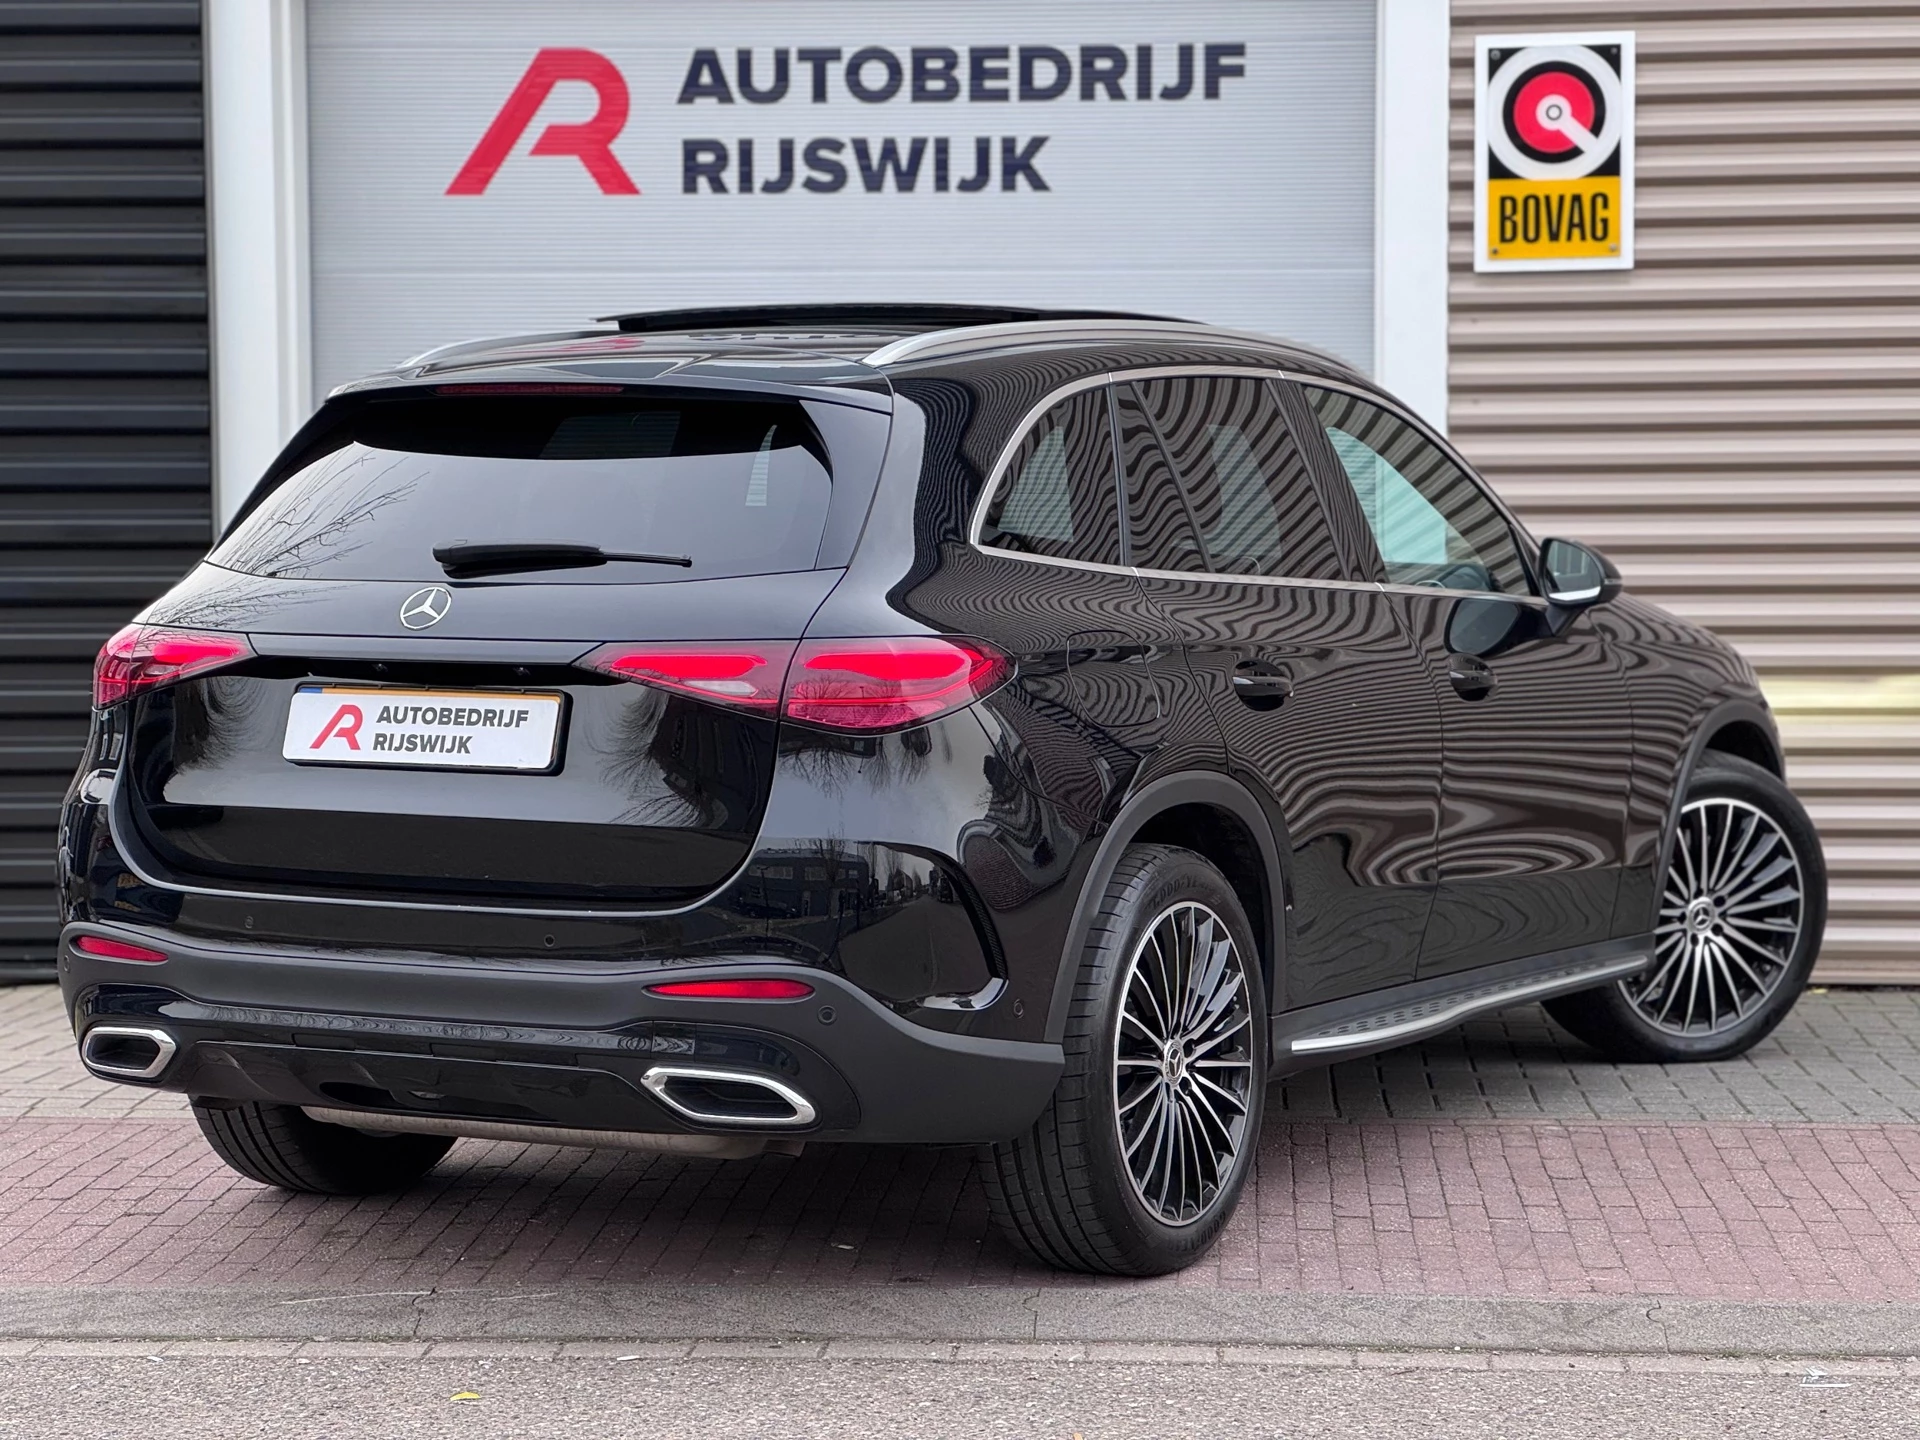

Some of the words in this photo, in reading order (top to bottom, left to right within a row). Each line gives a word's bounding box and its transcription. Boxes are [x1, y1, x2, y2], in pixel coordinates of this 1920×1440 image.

[677, 43, 1246, 105] AUTOBEDRIJF
[682, 136, 1050, 194] RIJSWIJK
[1500, 192, 1609, 243] BOVAG
[376, 705, 529, 728] AUTOBEDRIJF
[372, 733, 473, 754] RIJSWIJK
